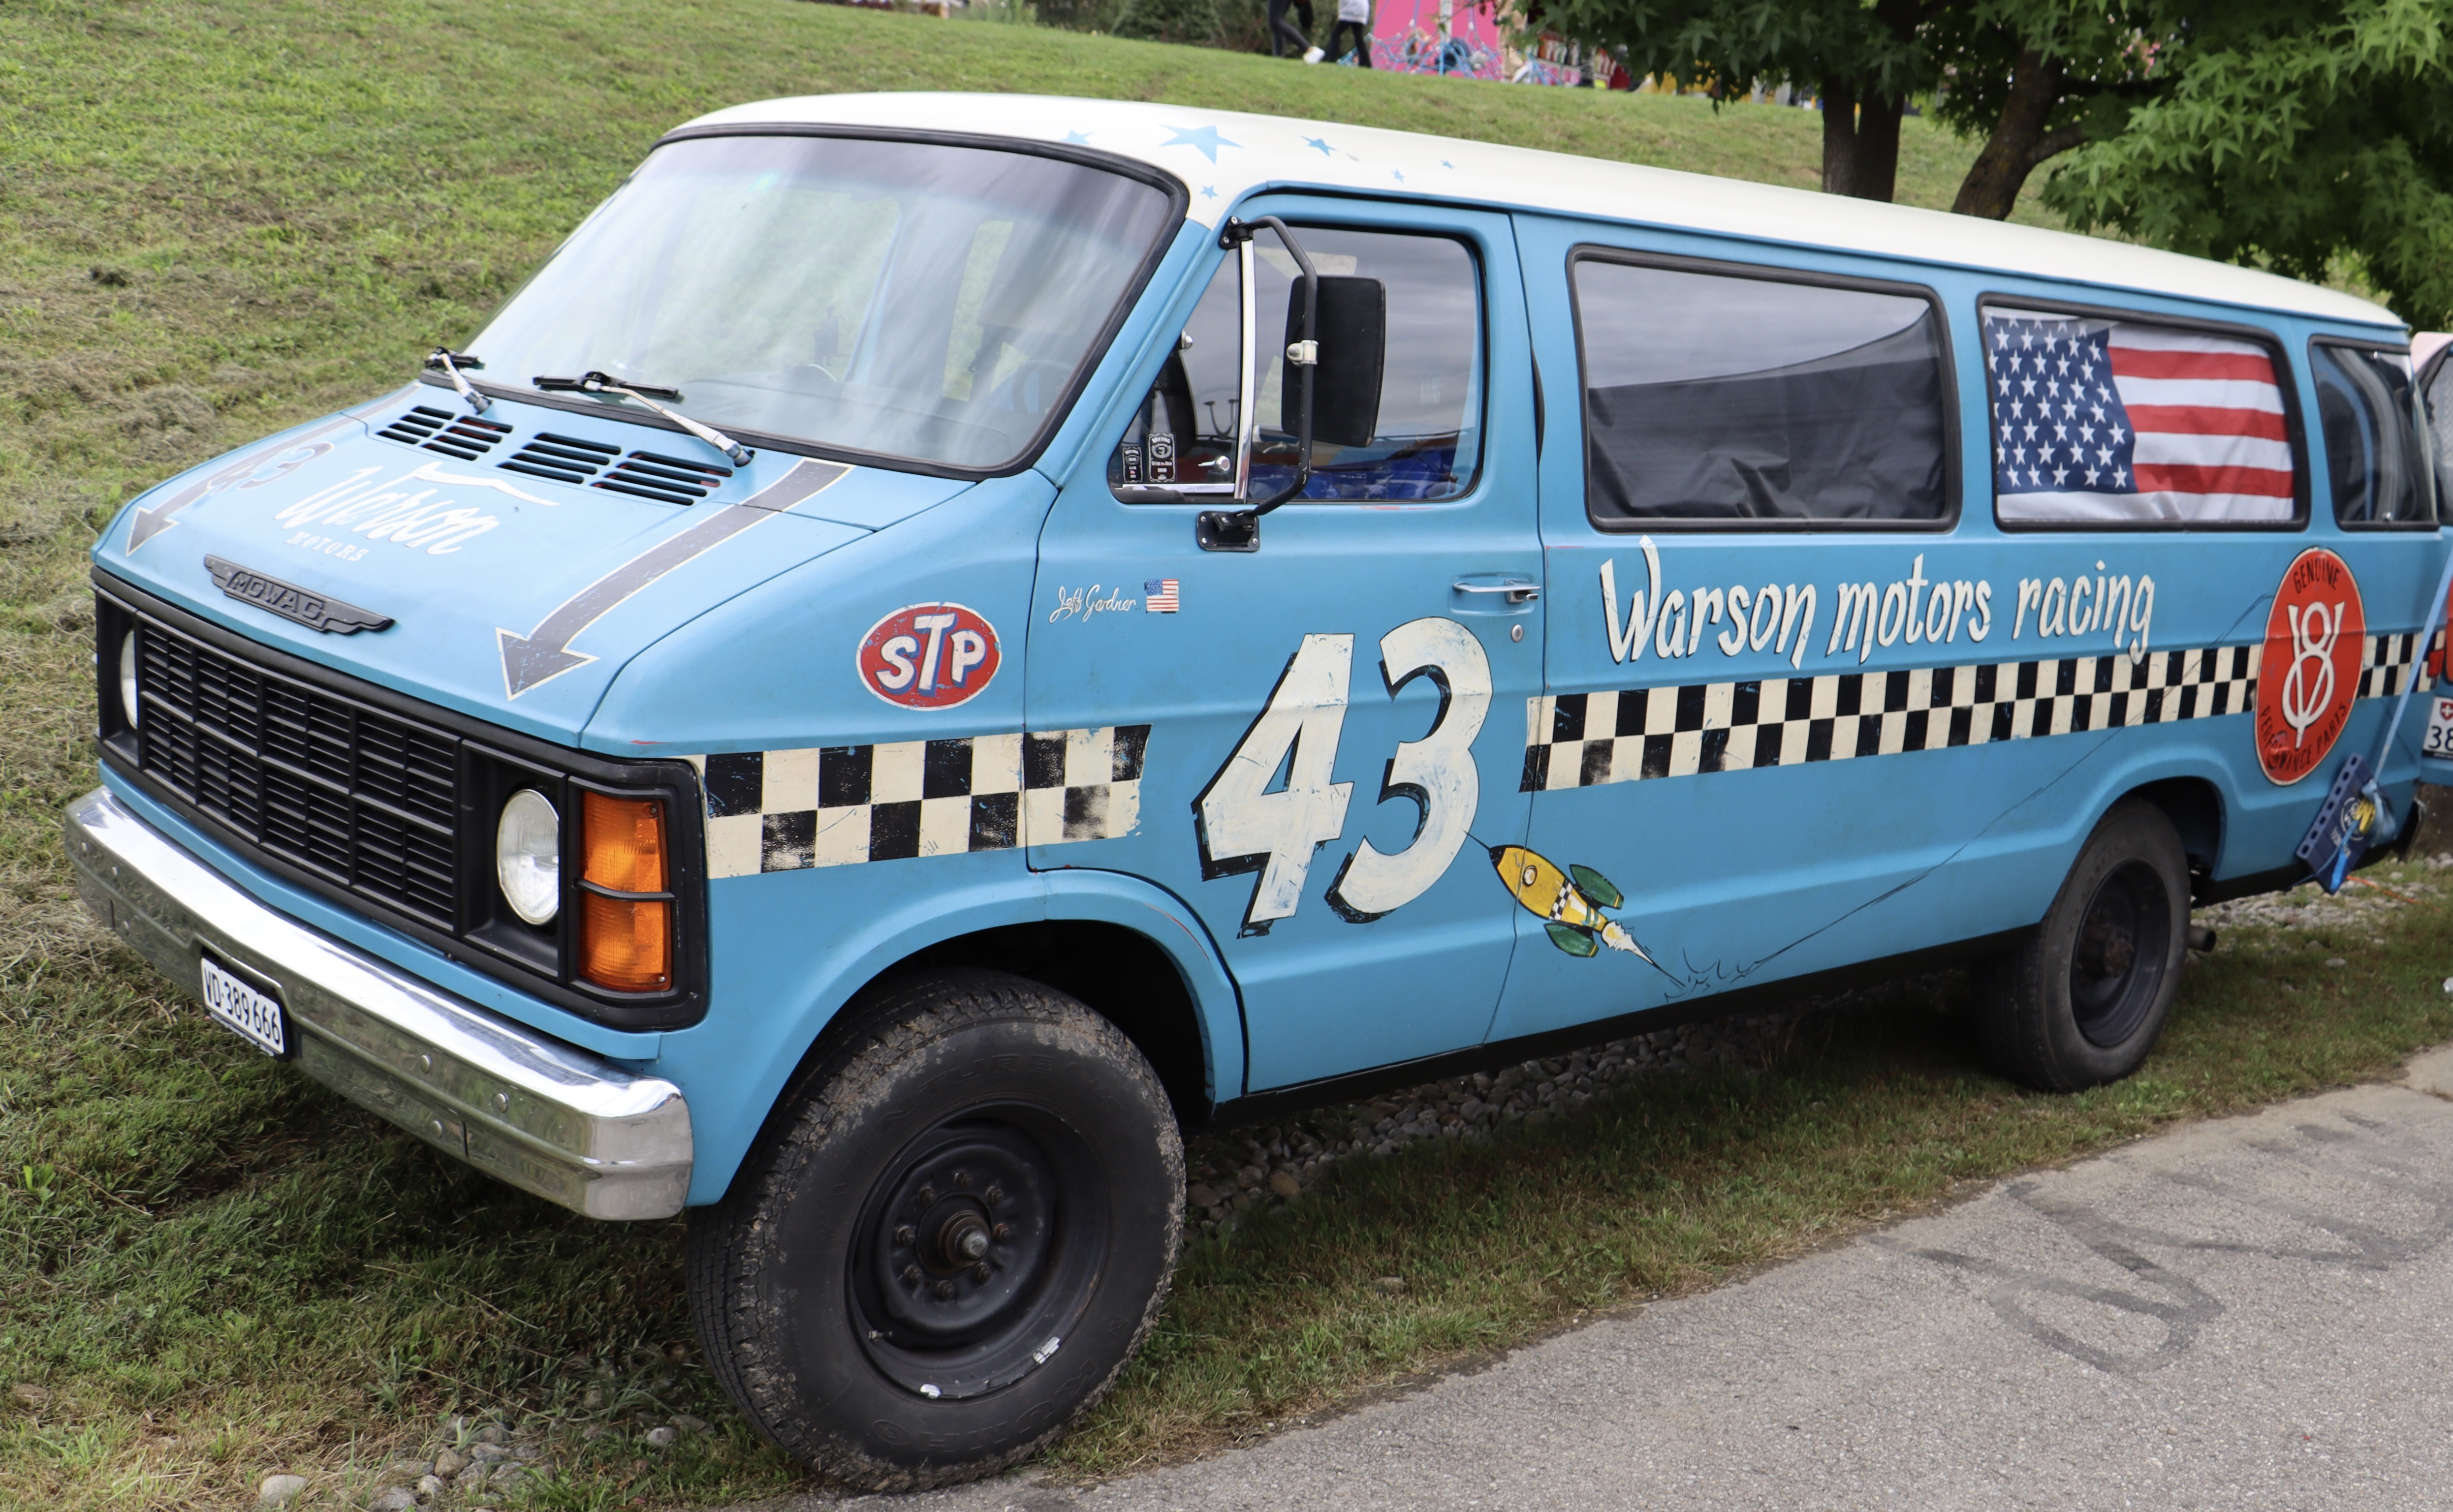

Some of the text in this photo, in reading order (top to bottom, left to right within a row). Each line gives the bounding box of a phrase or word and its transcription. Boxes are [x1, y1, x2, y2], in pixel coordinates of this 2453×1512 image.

[285, 531, 370, 562] MOTORS
[231, 573, 326, 620] MOWAG
[1600, 534, 2154, 670] Warson motors racing
[2294, 557, 2340, 594] GENUINE
[1049, 586, 1083, 623] Jeff
[874, 612, 987, 697] STP
[2317, 702, 2346, 755] PARTS
[1191, 616, 1493, 939] 43
[873, 1358, 1099, 1454] KUMHO
